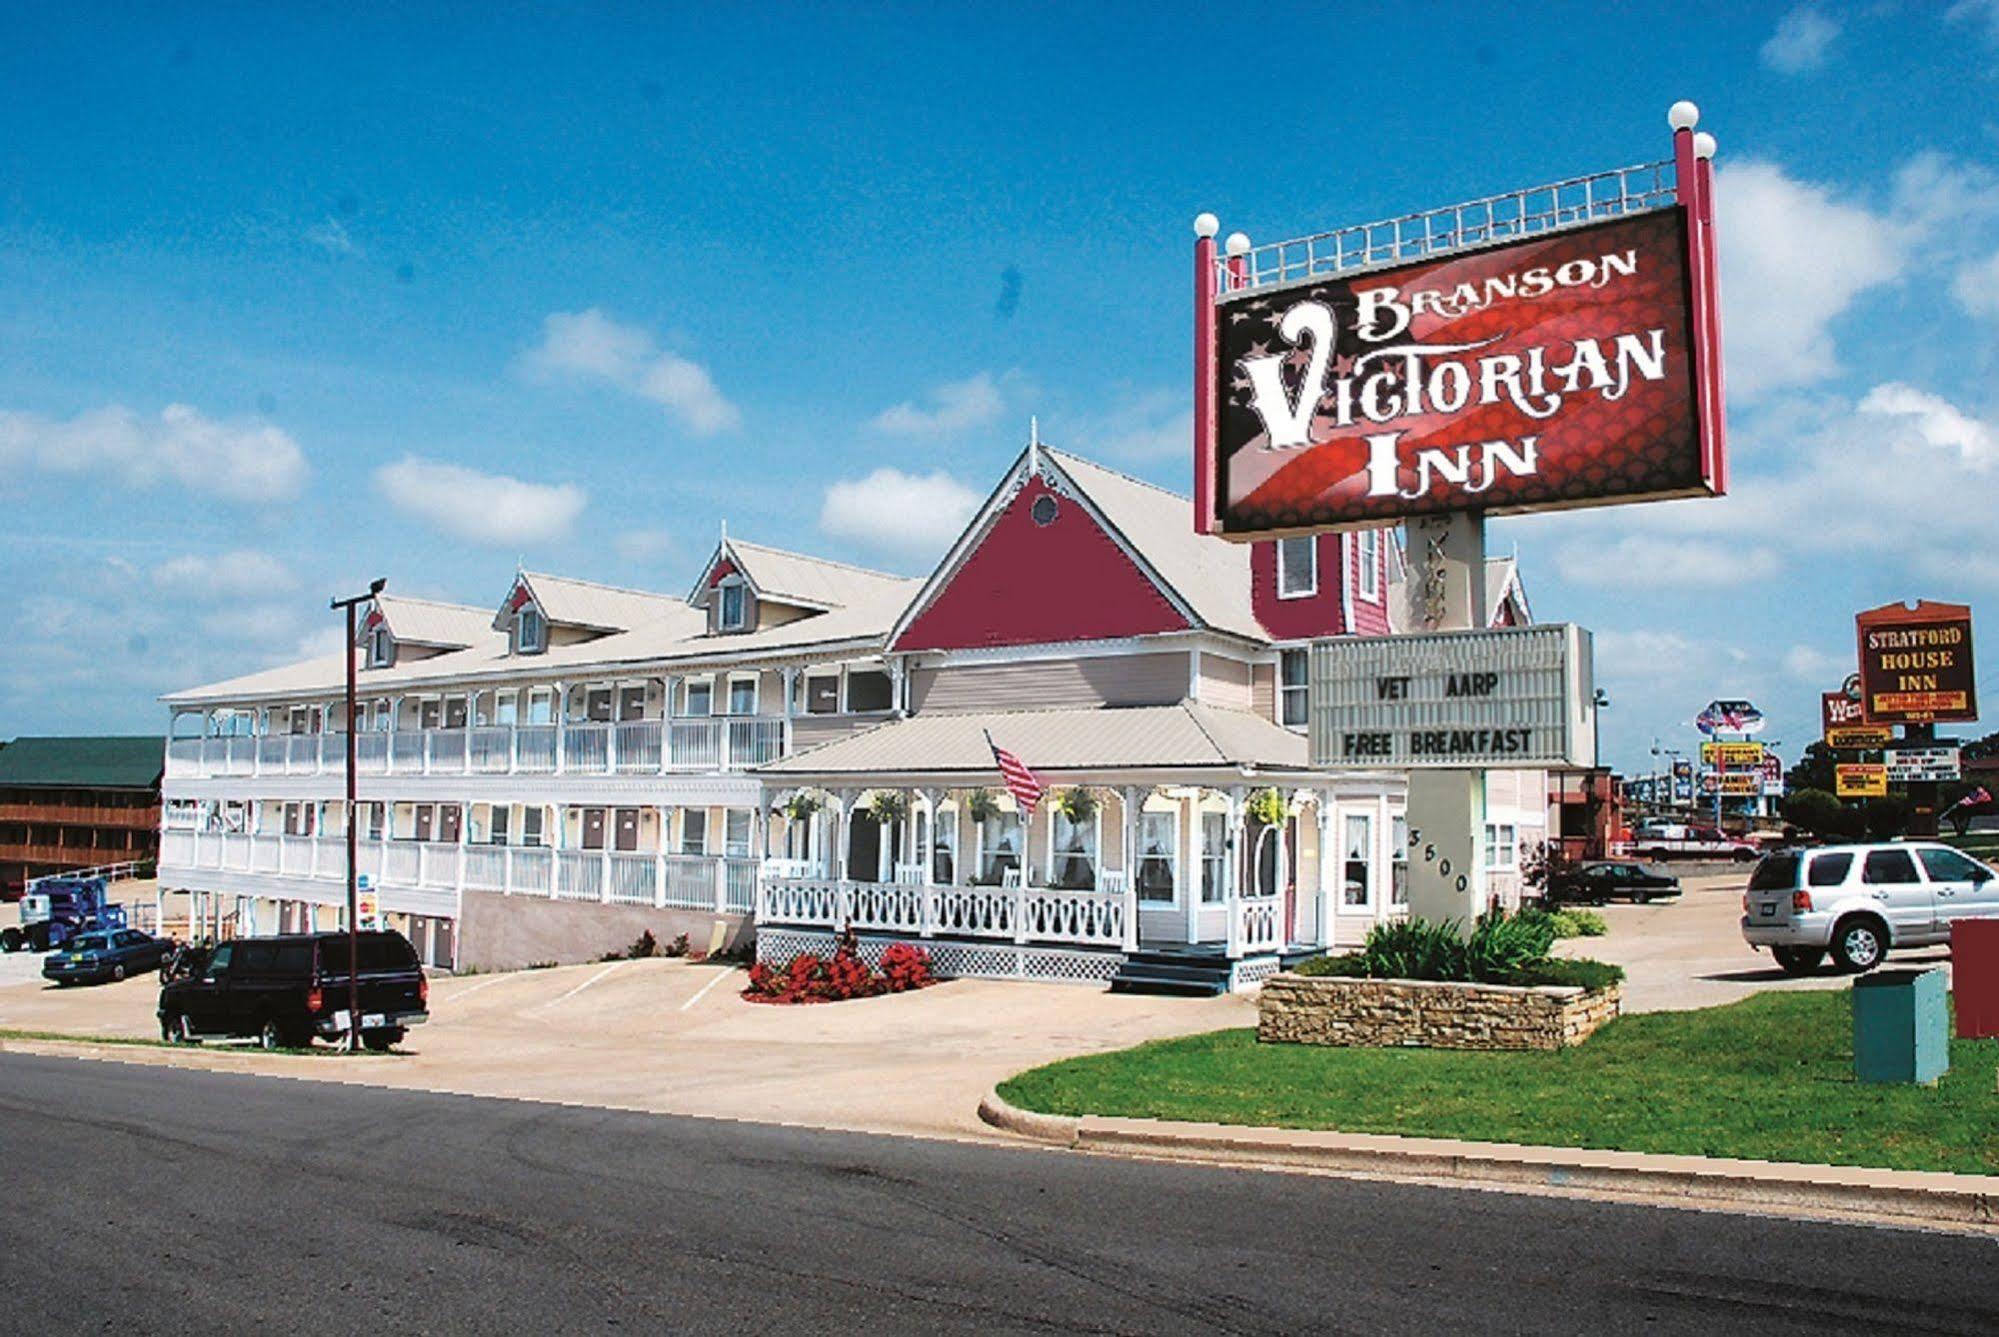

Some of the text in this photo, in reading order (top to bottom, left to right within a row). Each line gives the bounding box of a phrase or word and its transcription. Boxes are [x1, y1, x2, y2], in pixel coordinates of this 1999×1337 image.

[1363, 431, 1539, 500] INN
[1869, 627, 1962, 649] STRATFORD
[1881, 651, 1953, 670] HOUSE
[1376, 672, 1499, 700] VET AARP
[1898, 675, 1937, 691] INN
[1343, 729, 1532, 757] FREE BREAKFAST
